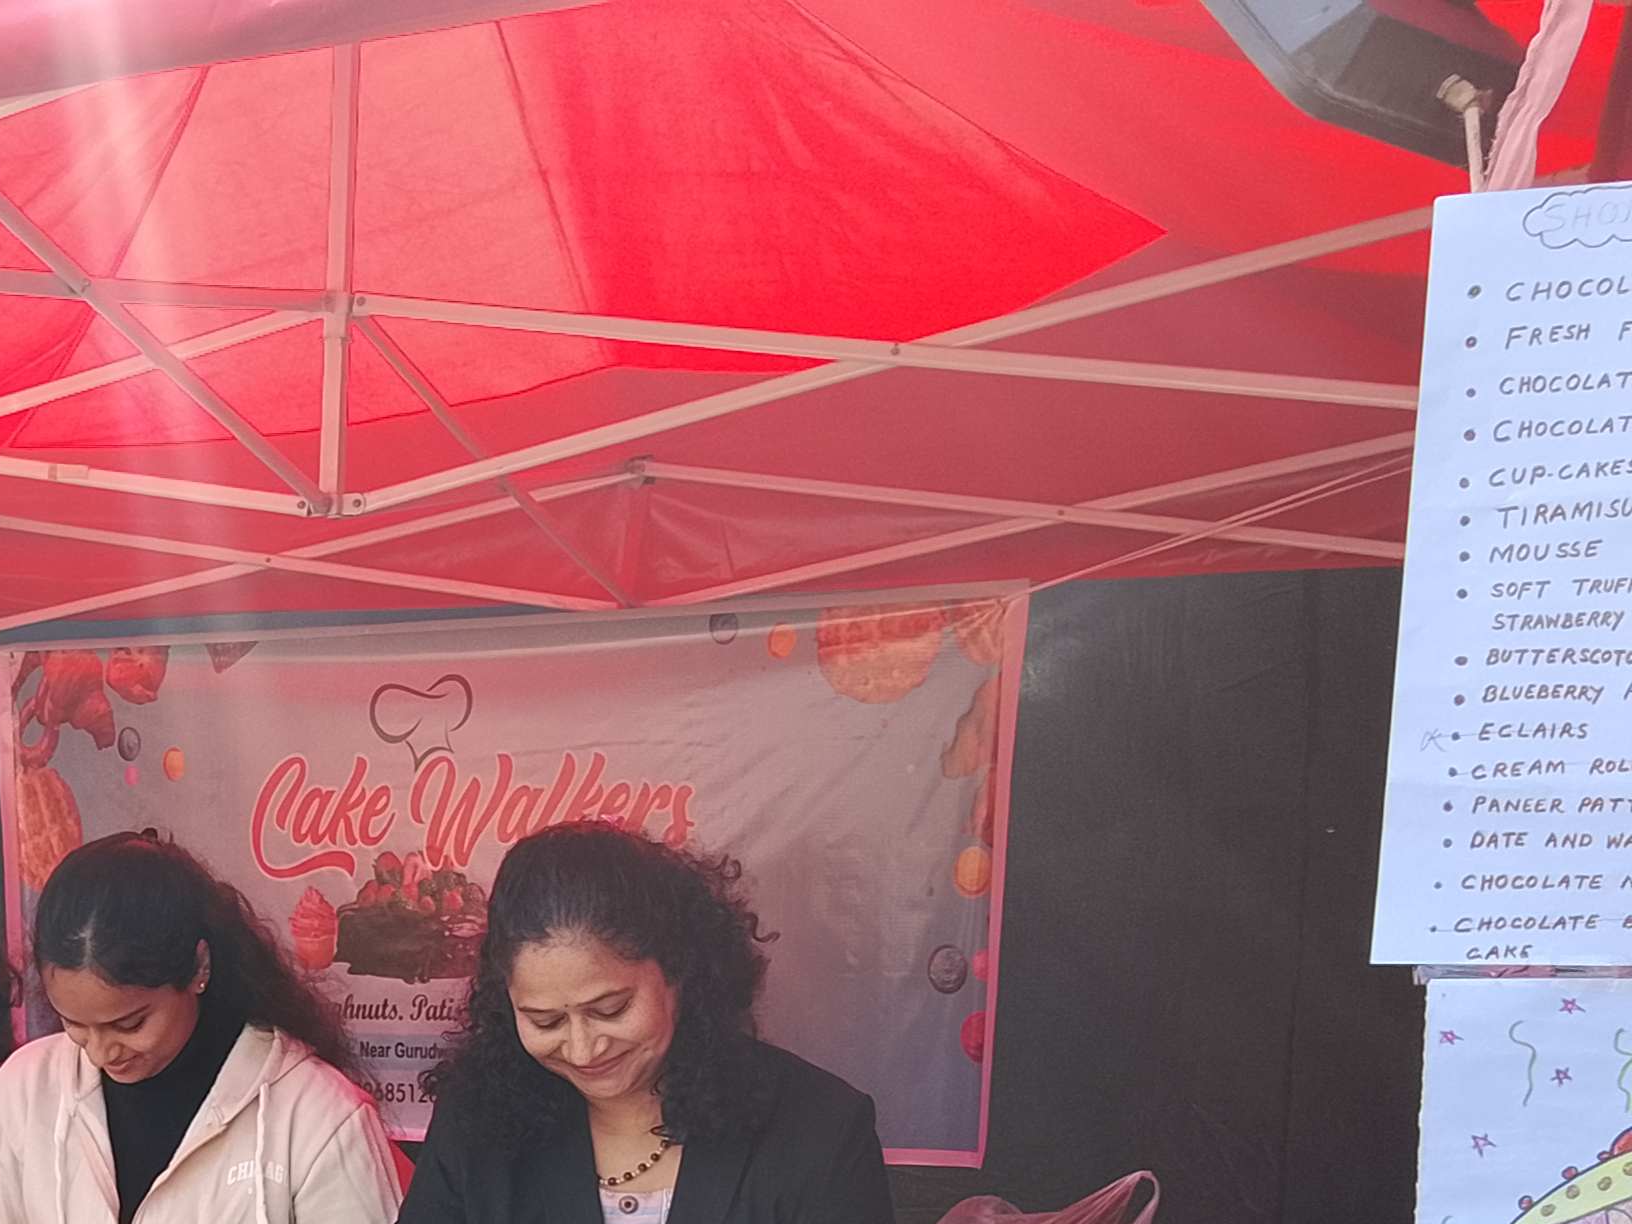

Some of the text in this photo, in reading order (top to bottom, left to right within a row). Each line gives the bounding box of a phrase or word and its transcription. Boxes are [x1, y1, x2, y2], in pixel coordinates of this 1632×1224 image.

[1506, 276, 1630, 301] CHOCOL
[1505, 323, 1591, 350] FRESH
[1499, 371, 1632, 395] CHOCOLAT
[1493, 415, 1632, 442] CHOCOLAT
[1489, 539, 1603, 563] MOUSSE
[1491, 580, 1551, 600] SOFT
[1492, 610, 1625, 632] STRAWBERRY
[1482, 684, 1604, 705] BLUEBERRY
[1478, 722, 1588, 741] ECLAIRS
[1471, 759, 1565, 780] CREAM
[1472, 795, 1565, 814] PANEER
[250, 753, 695, 878] Cake Walkers
[1470, 830, 1529, 849] DATE
[1545, 832, 1593, 849] AND
[1461, 874, 1603, 891] CHOCOLATE
[1454, 914, 1600, 933] CHOCOLATE
[1466, 945, 1533, 960] CAKE
[360, 1042, 391, 1059] Near
